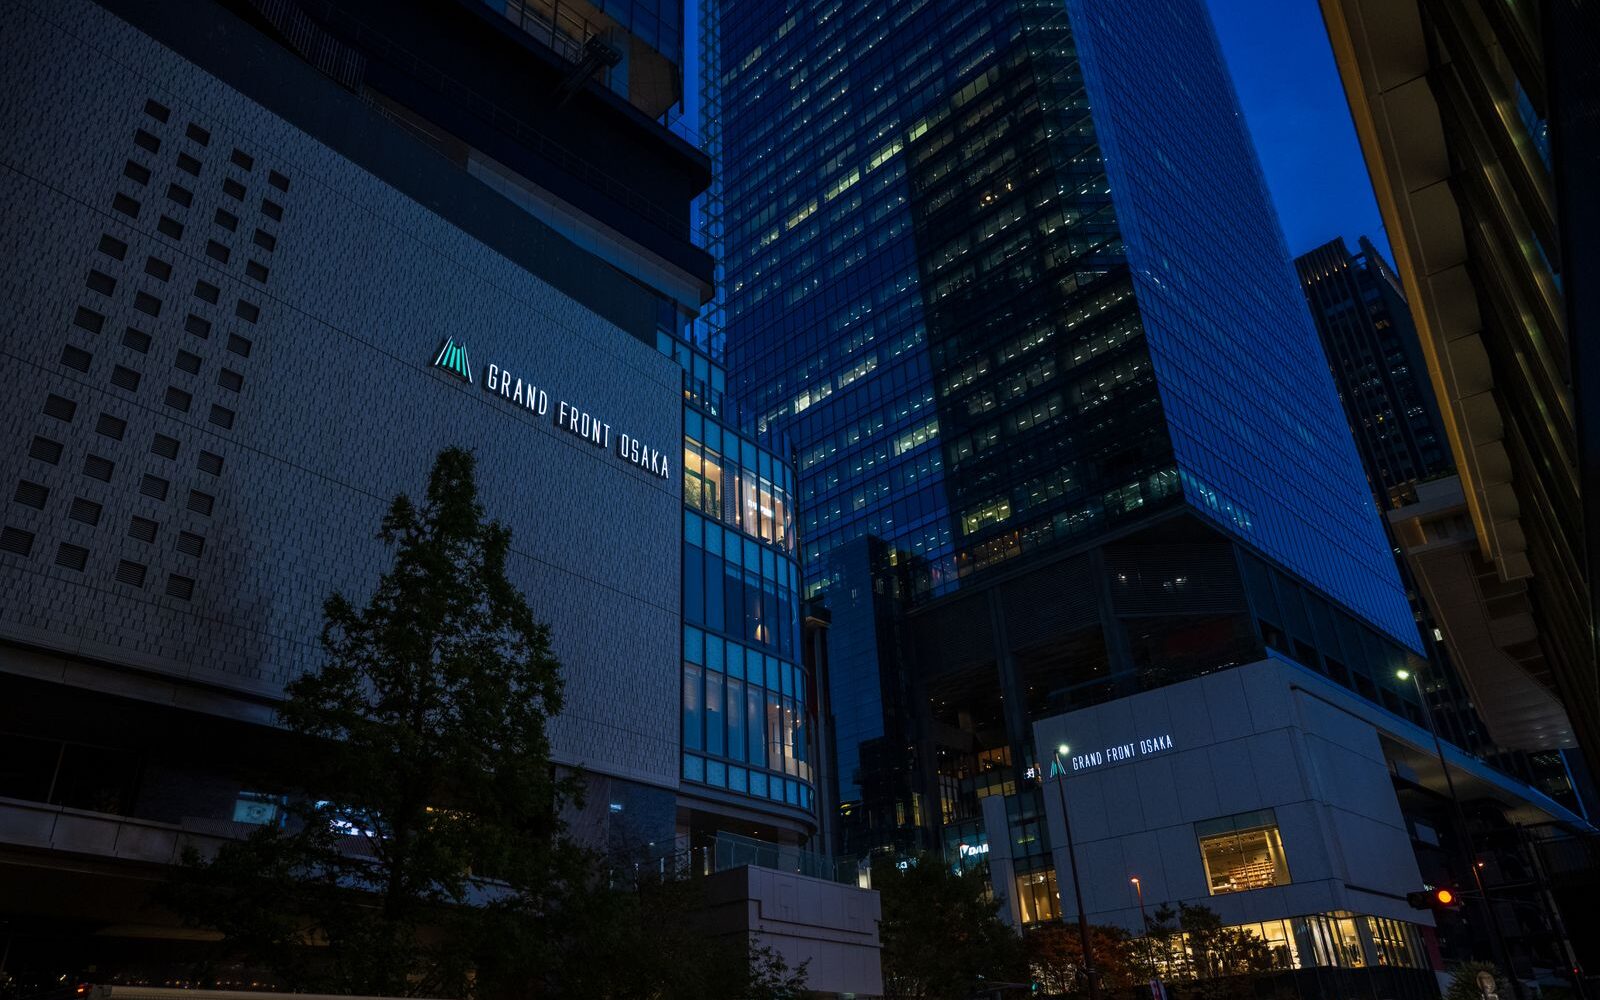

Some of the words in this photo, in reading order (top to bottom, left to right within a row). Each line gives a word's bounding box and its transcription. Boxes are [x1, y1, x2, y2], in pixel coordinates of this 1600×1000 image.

[487, 363, 548, 415] GRAND
[559, 400, 611, 448] FRONT
[621, 433, 669, 479] OSAKA
[1072, 752, 1103, 771] GRAND
[1106, 743, 1136, 762] FRONT
[1140, 734, 1173, 755] OSAKA
